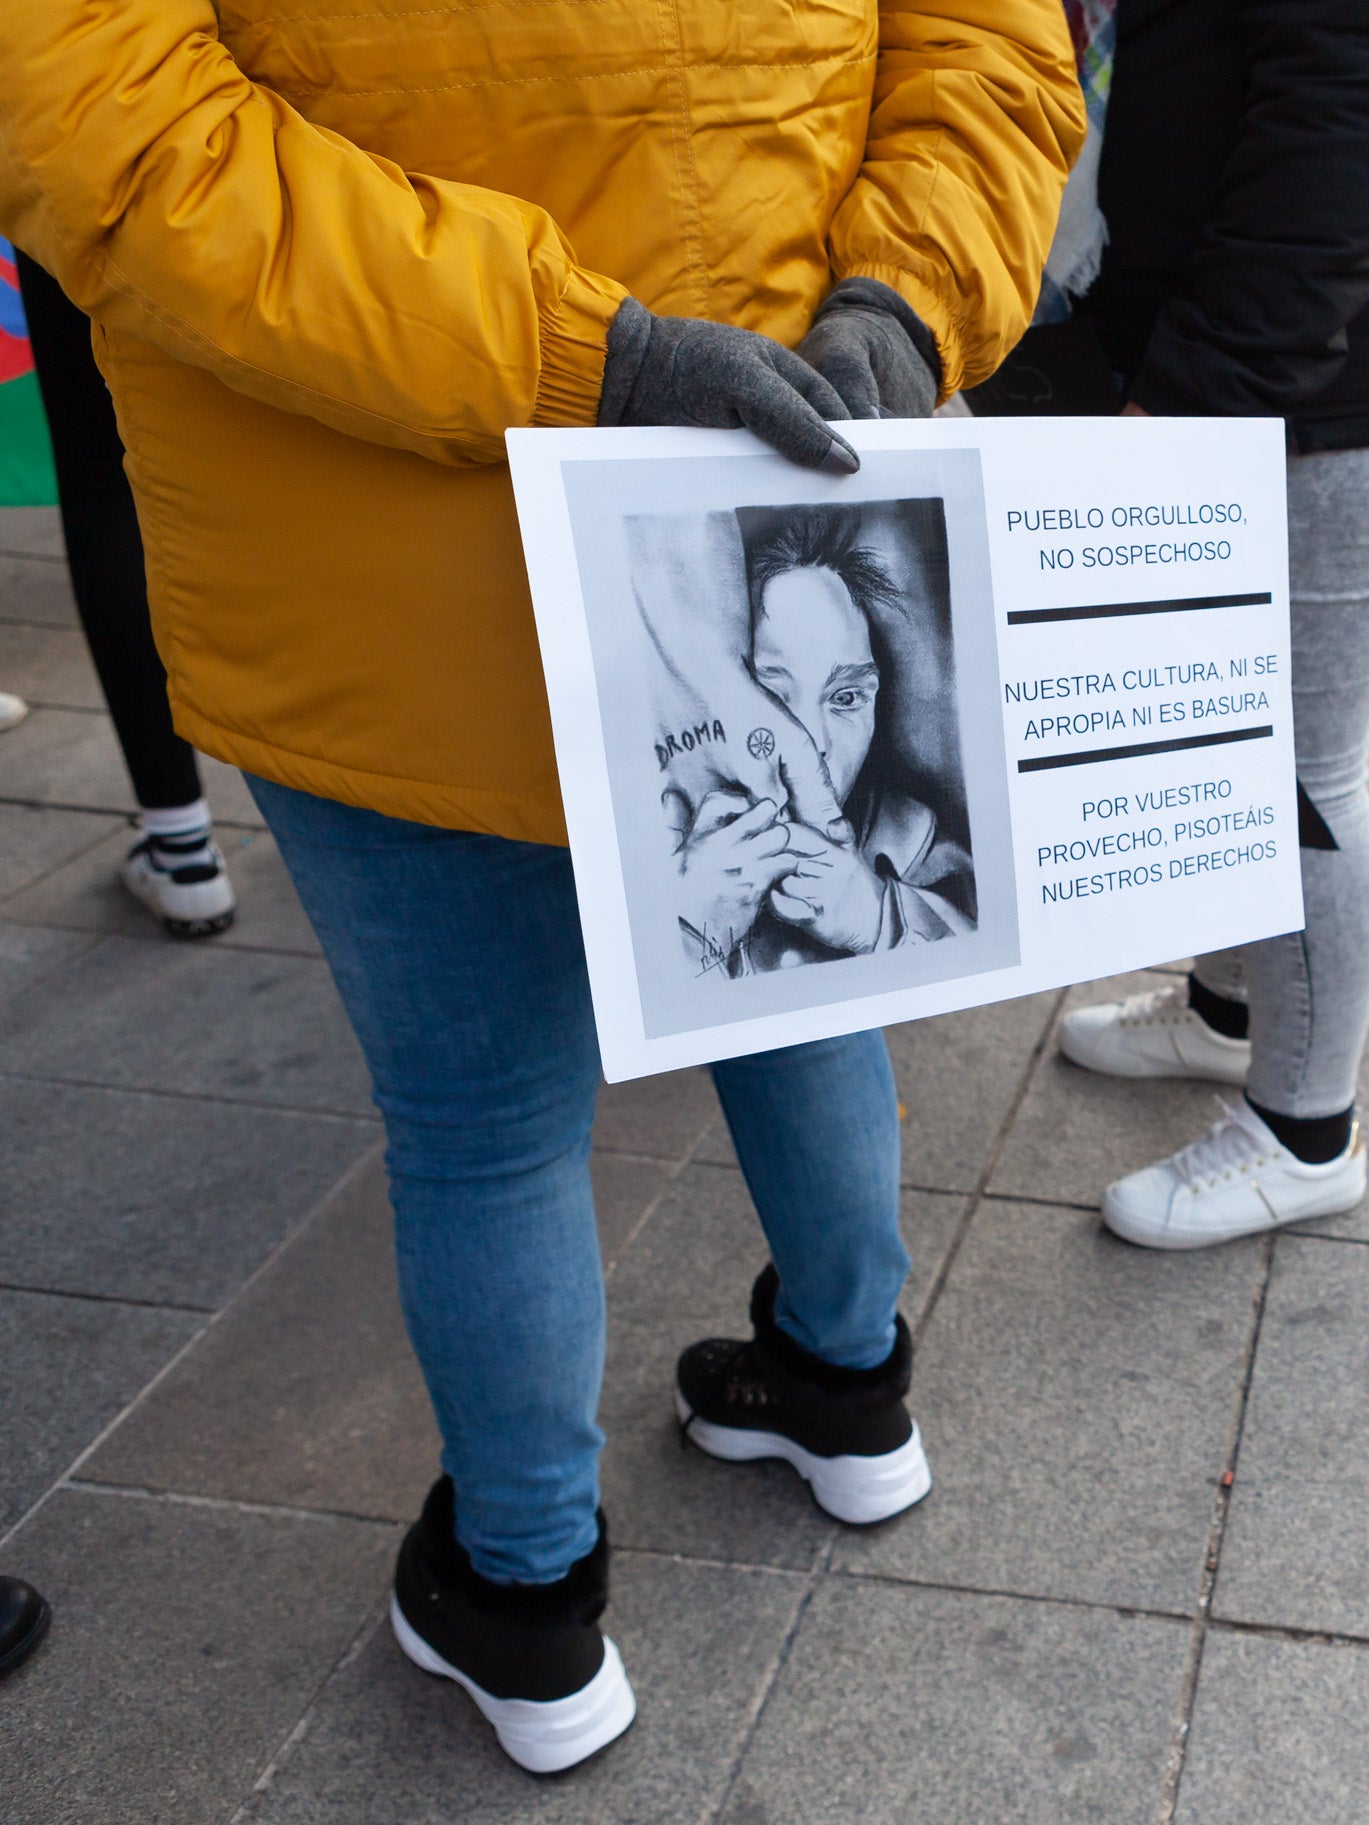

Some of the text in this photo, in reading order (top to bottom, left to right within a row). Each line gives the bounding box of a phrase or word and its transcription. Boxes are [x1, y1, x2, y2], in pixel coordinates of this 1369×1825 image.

[1007, 503, 1248, 532] PUEBLO ORGULLOSO,
[1039, 540, 1232, 571] NO SOSPECHOSO
[1004, 654, 1278, 704] NUESTRA CULTURA, NI SE
[1023, 691, 1270, 741] APROPIA NI ES BASURA
[1082, 779, 1232, 822] POR VUESTRO
[1037, 806, 1275, 868] PROVECHO, PISOTEÁIS
[1042, 840, 1277, 905] NUESTROS DERECHOS
